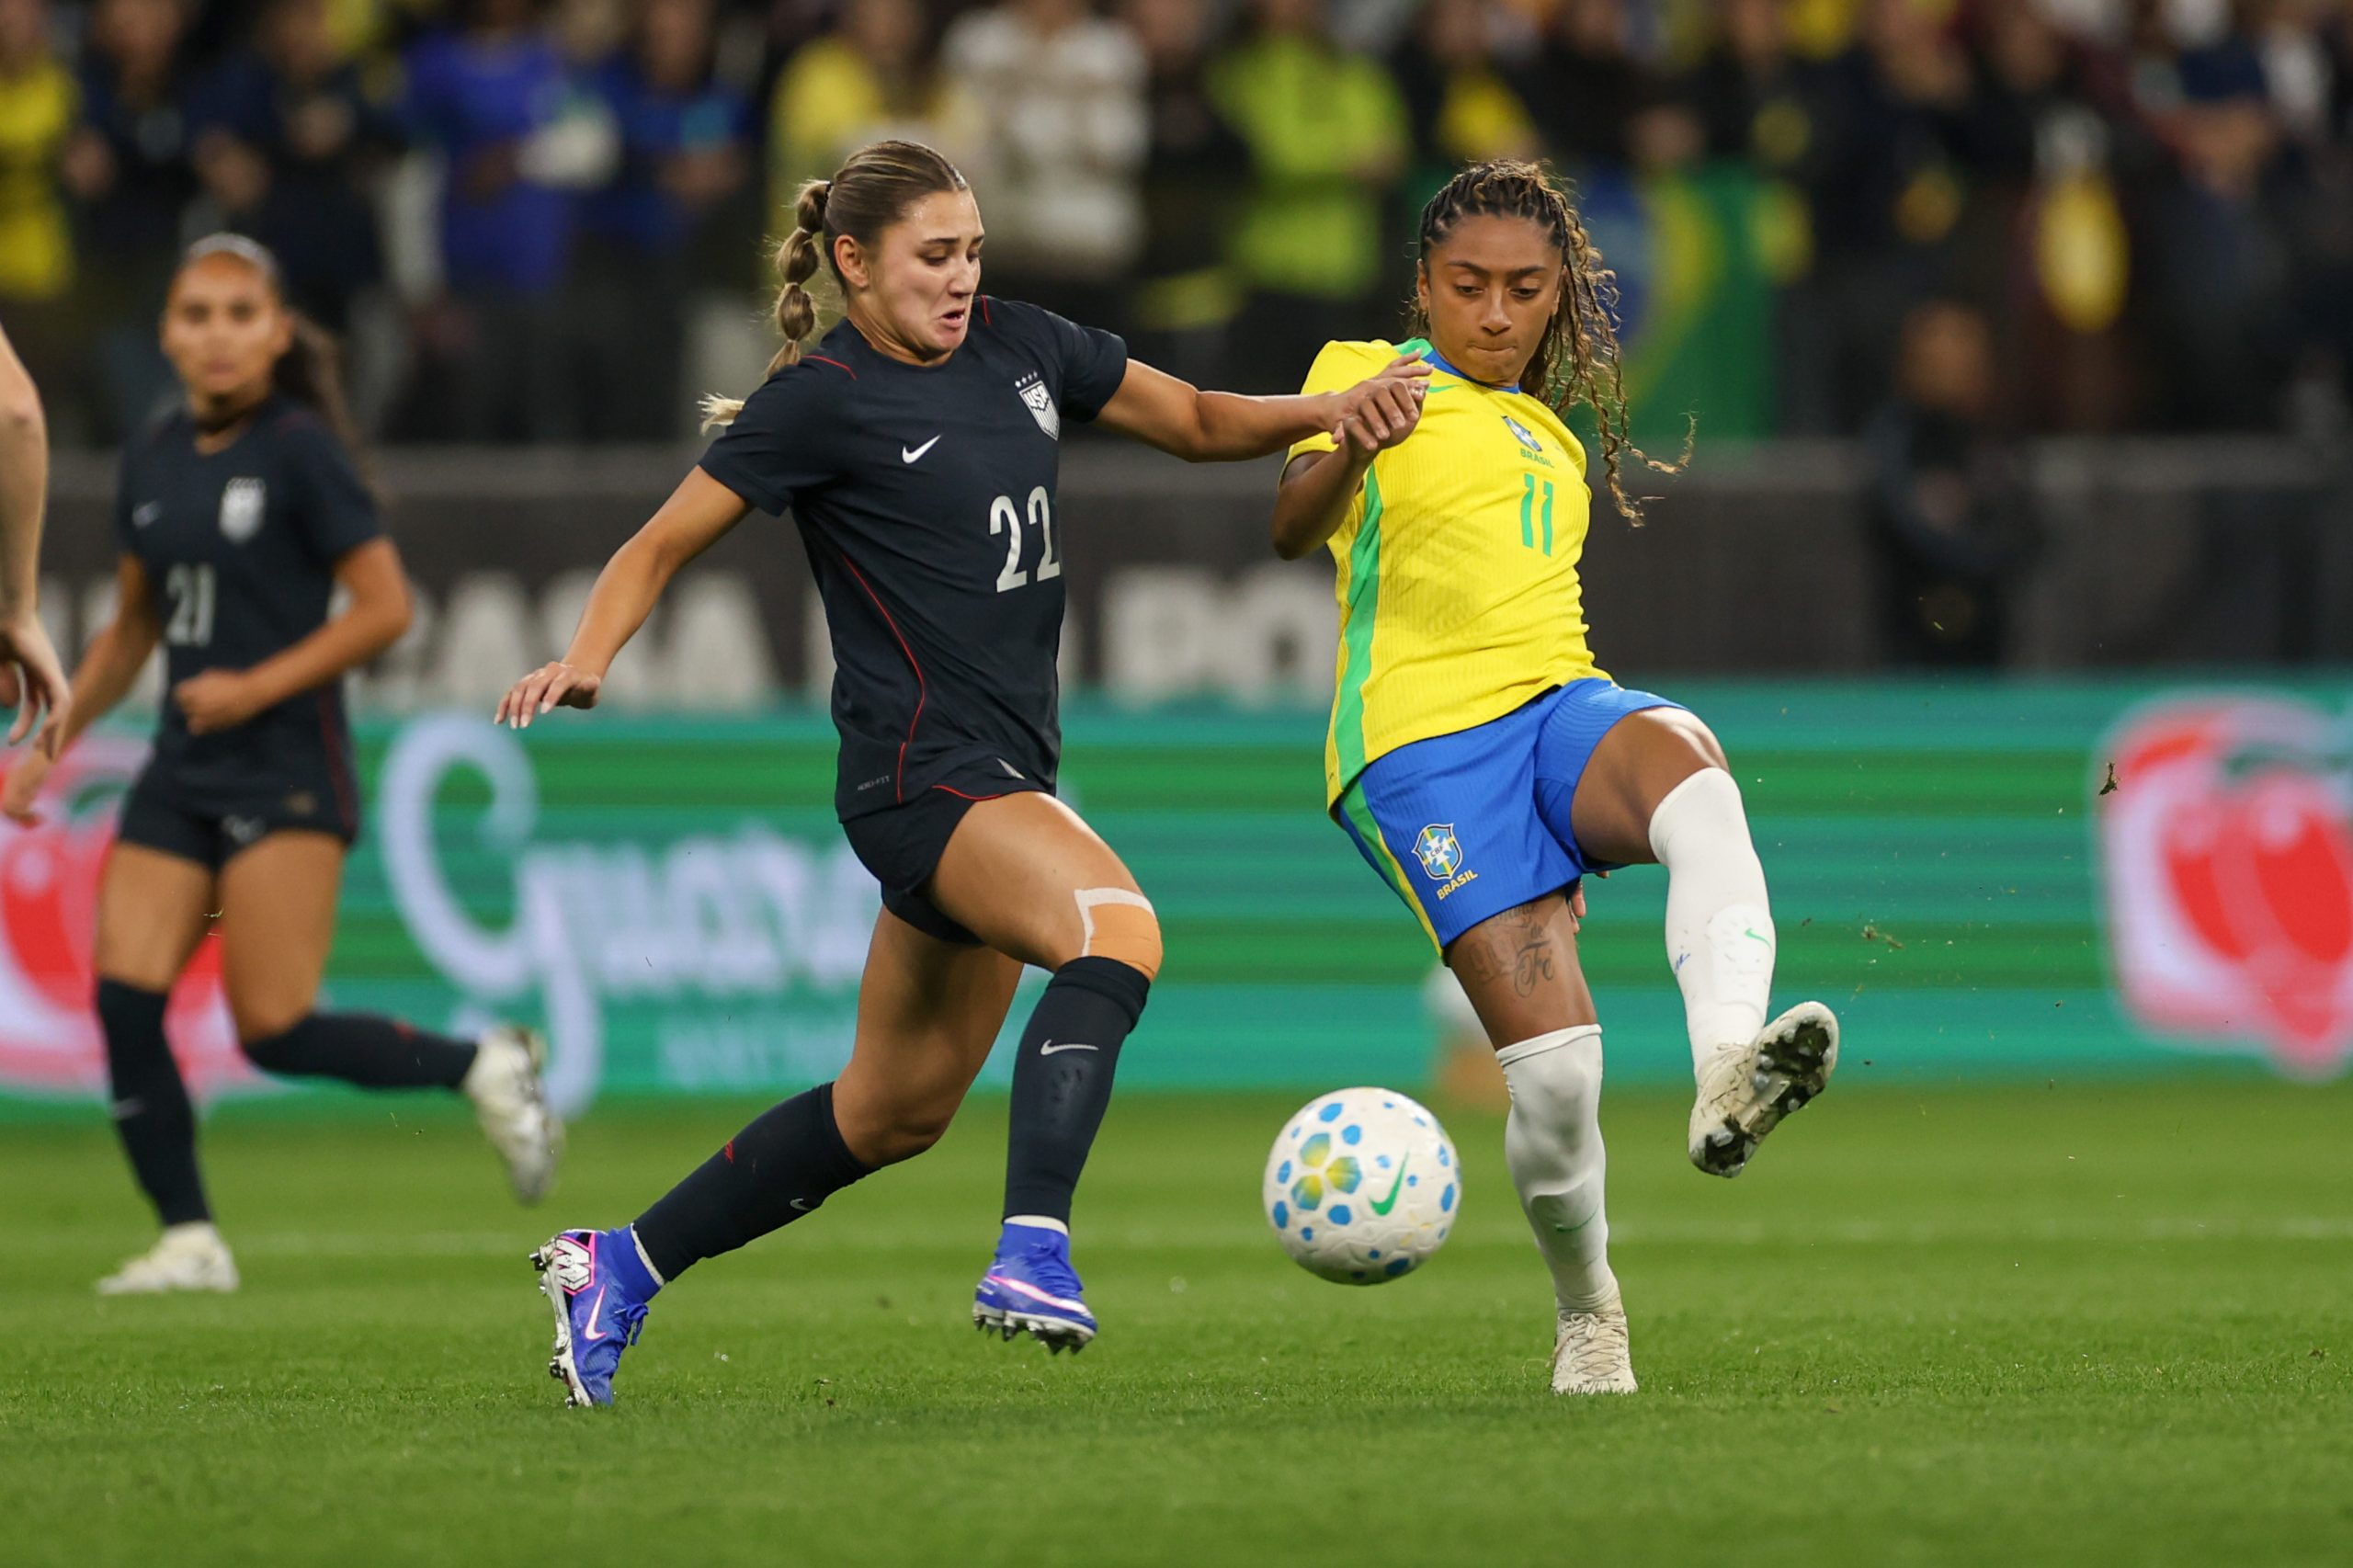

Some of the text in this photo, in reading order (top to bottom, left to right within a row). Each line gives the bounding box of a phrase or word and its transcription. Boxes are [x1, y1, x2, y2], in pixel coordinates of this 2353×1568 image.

[1022, 384, 1049, 411] USA
[1520, 448, 1554, 468] BRASIL
[990, 485, 1061, 593] 22
[1520, 472, 1553, 558] 11
[165, 563, 216, 646] 21
[1436, 869, 1478, 900] BRASIL
